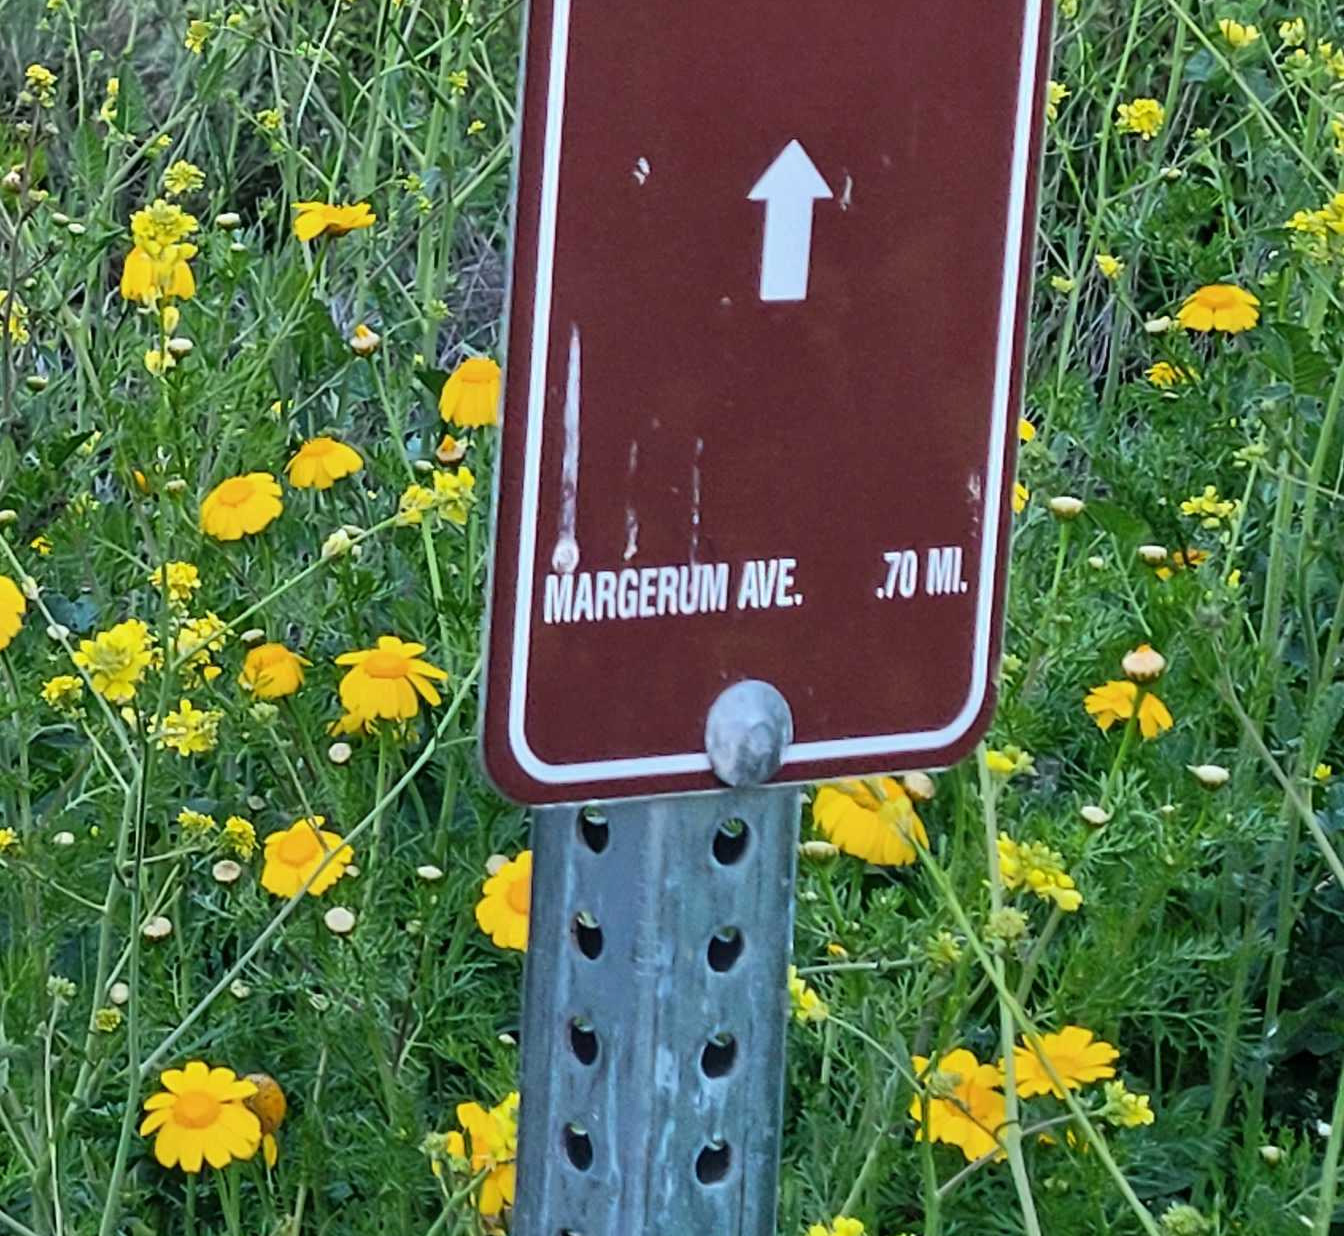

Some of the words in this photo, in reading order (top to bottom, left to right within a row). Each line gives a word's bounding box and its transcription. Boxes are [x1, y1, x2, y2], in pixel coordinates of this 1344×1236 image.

[543, 562, 730, 624] MARGERUM
[737, 557, 803, 611] AVE.
[875, 549, 918, 599] .70
[926, 546, 968, 595] MI.
